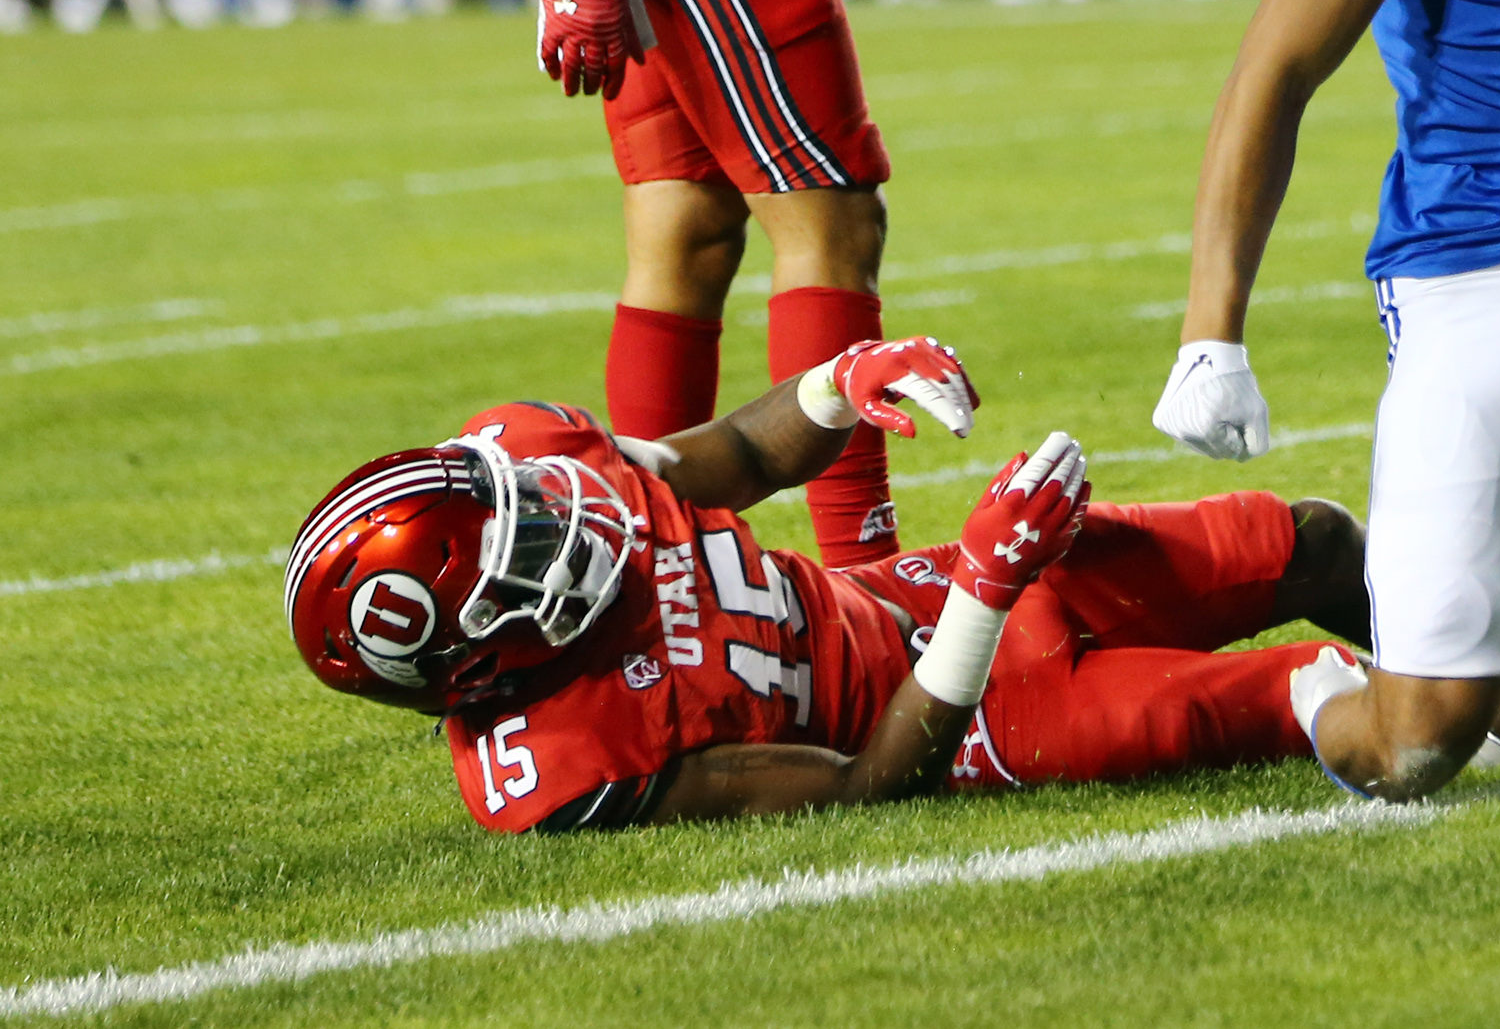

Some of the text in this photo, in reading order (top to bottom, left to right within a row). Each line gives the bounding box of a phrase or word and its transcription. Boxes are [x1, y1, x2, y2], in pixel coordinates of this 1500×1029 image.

[357, 579, 434, 649] U
[654, 541, 703, 668] UTAH
[701, 528, 812, 730] 15
[476, 715, 539, 815] 15
